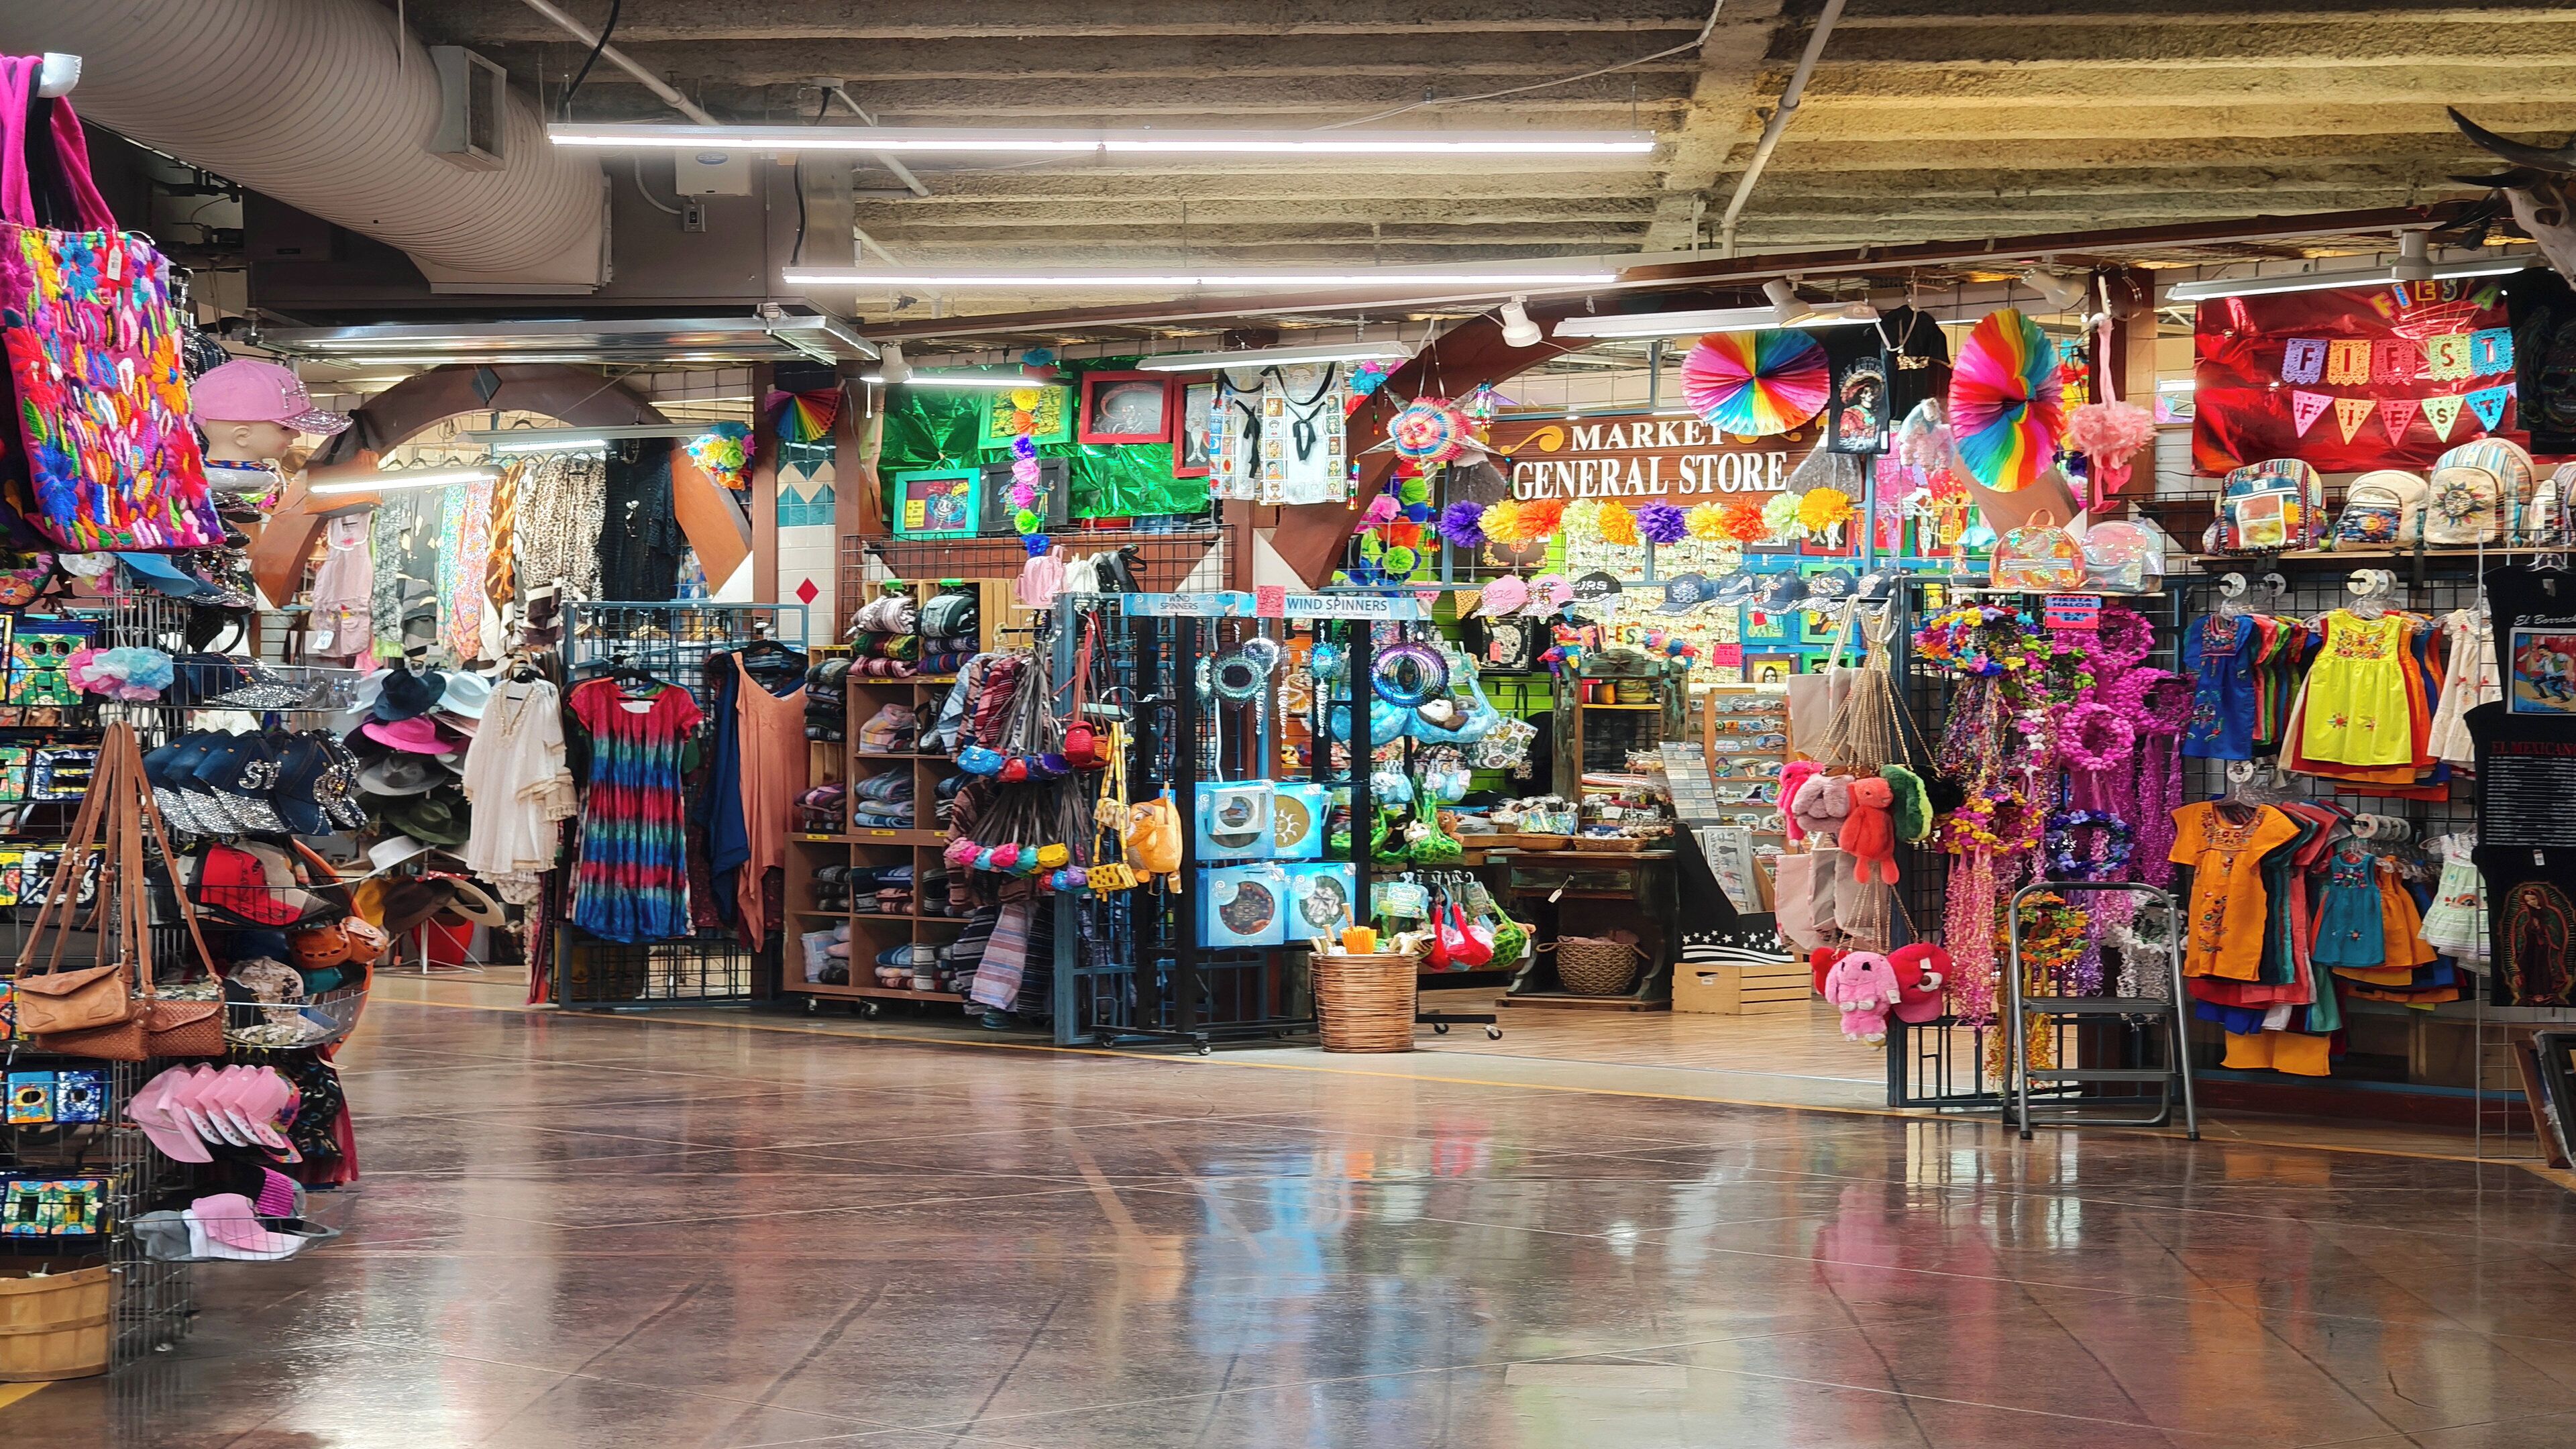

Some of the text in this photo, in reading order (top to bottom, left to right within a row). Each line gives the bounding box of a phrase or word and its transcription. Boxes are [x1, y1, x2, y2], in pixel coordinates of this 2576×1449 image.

[1570, 419, 1725, 451] MARKET
[1513, 451, 1788, 501] GENERAL STORE
[1287, 598, 1322, 610] WIND
[1326, 598, 1387, 611] SPINNERS
[2514, 614, 2531, 626] El
[2490, 741, 2509, 754] EL
